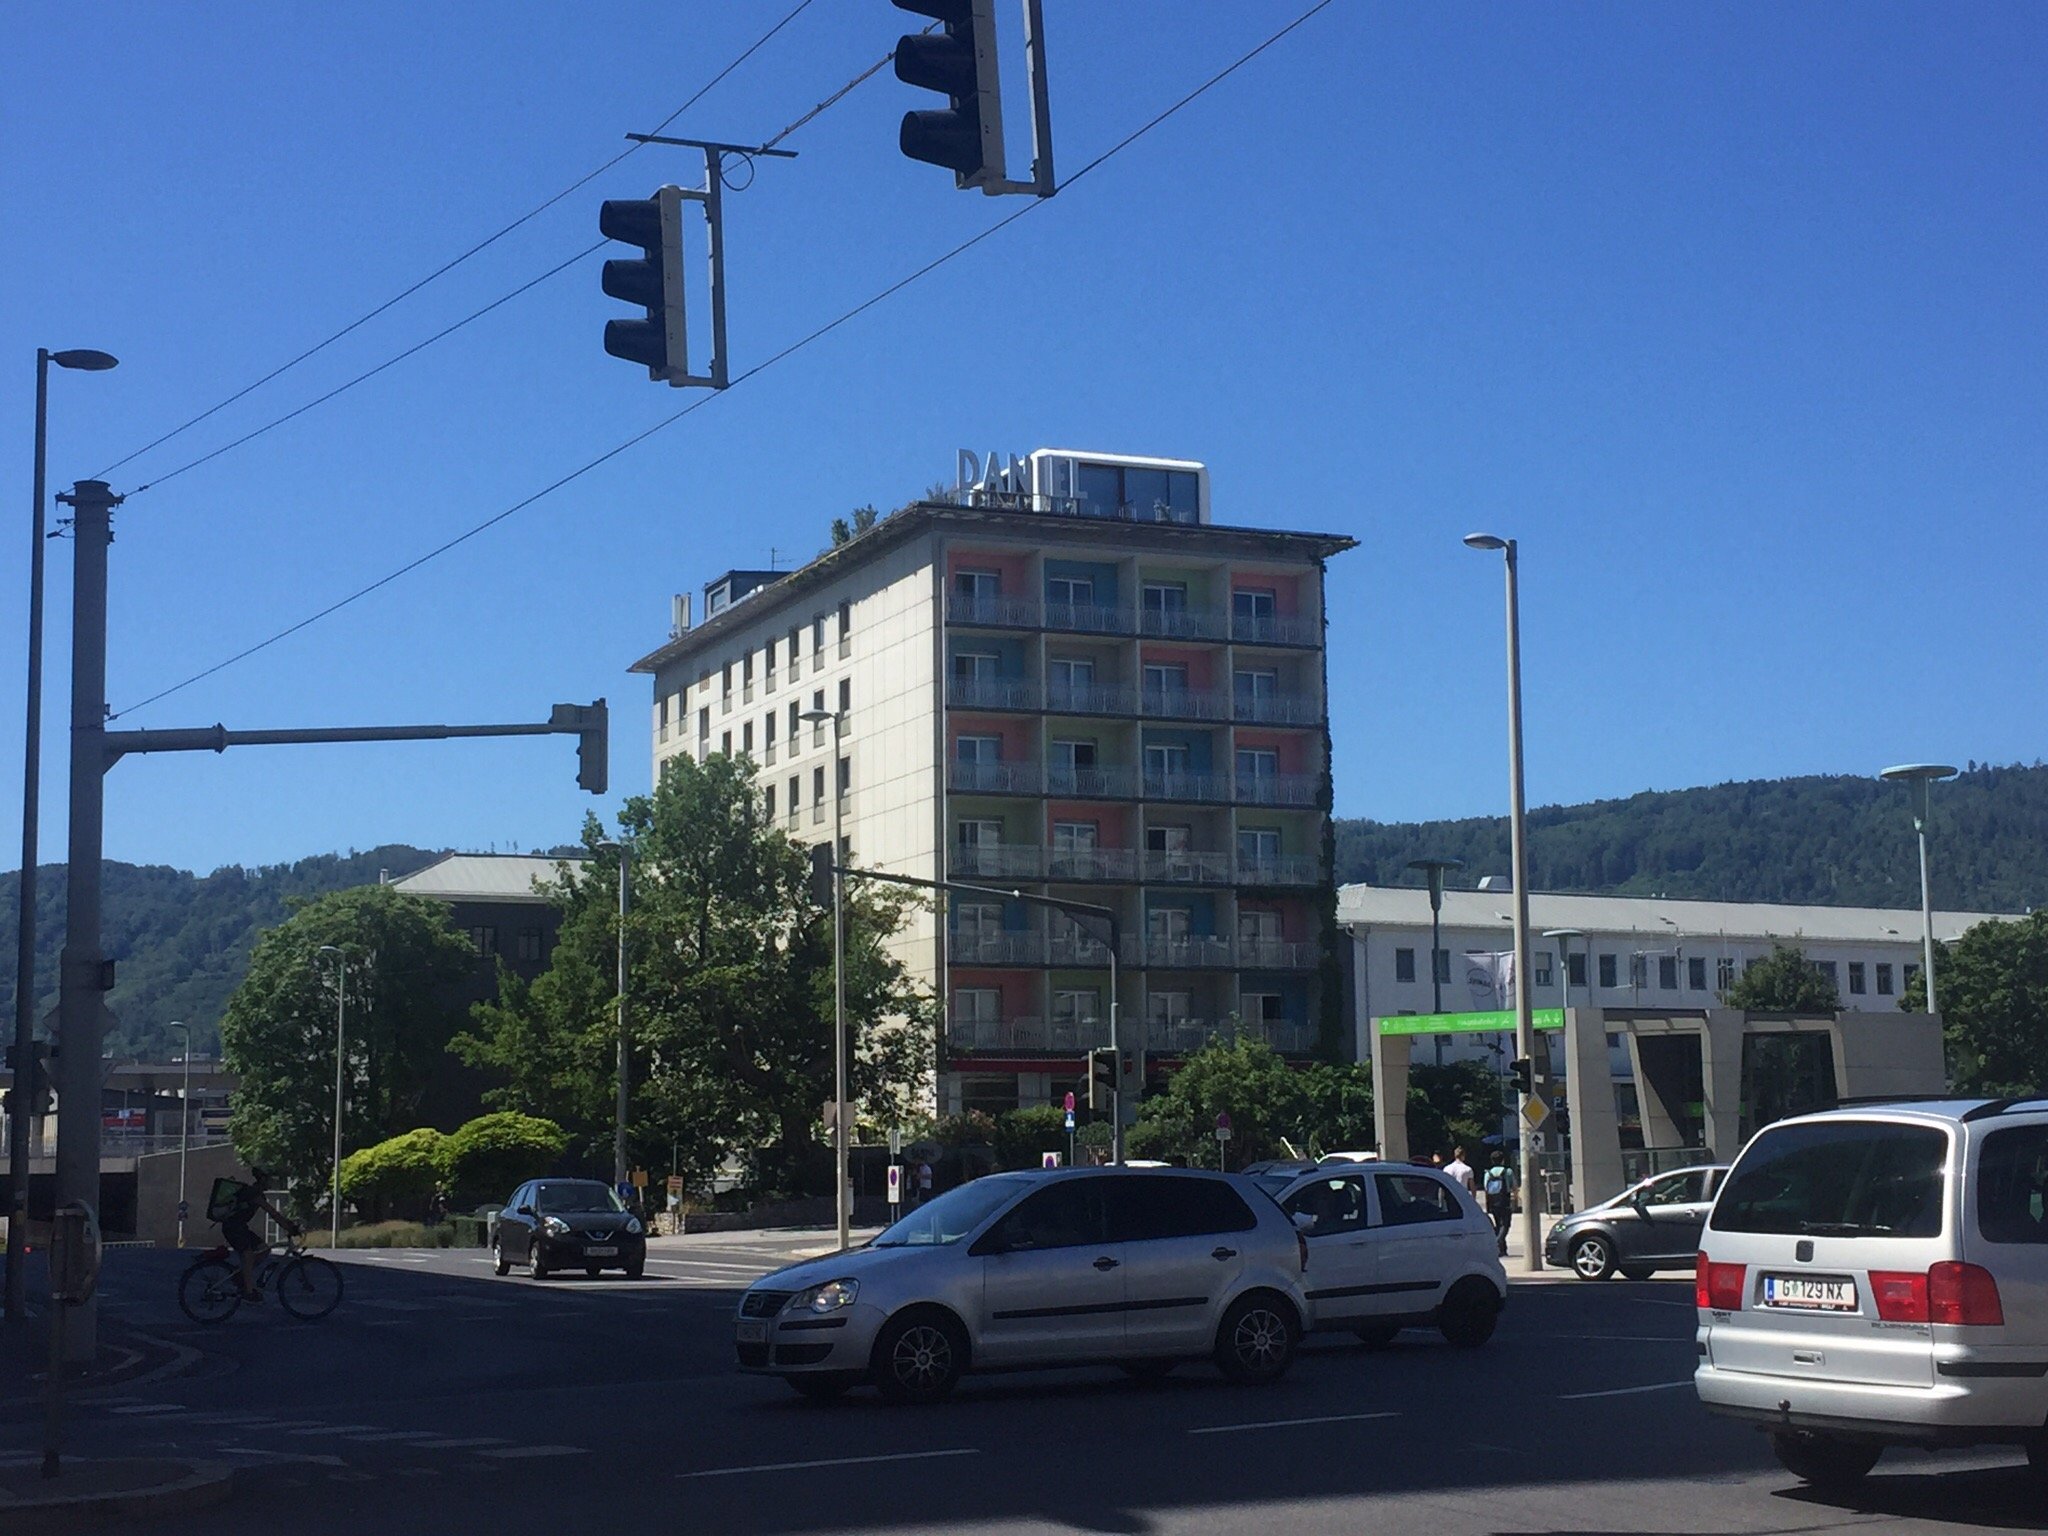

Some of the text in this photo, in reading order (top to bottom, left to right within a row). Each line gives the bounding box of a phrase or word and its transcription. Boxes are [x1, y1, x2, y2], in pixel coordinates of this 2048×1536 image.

[957, 448, 1089, 499] DANIEL
[1783, 1279, 1844, 1301] G 129 NX
